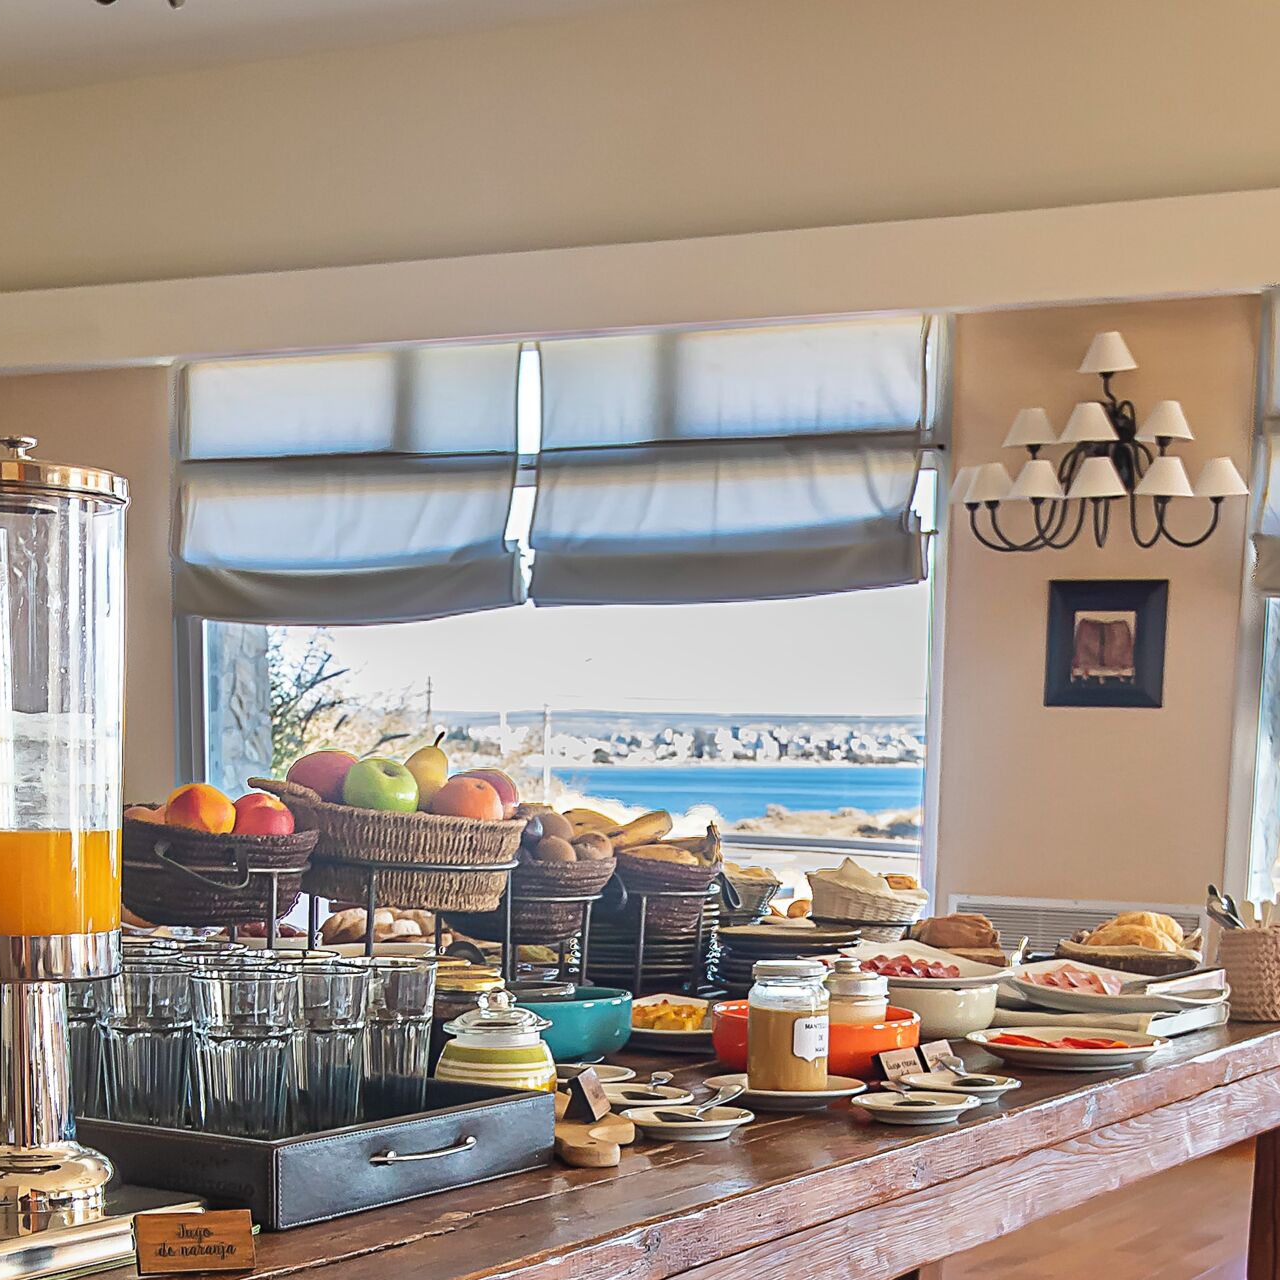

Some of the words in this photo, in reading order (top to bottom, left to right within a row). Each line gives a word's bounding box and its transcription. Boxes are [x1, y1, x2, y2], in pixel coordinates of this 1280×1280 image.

[177, 1223, 213, 1243] Jugo
[157, 1242, 175, 1258] de
[180, 1243, 237, 1260] naranja
